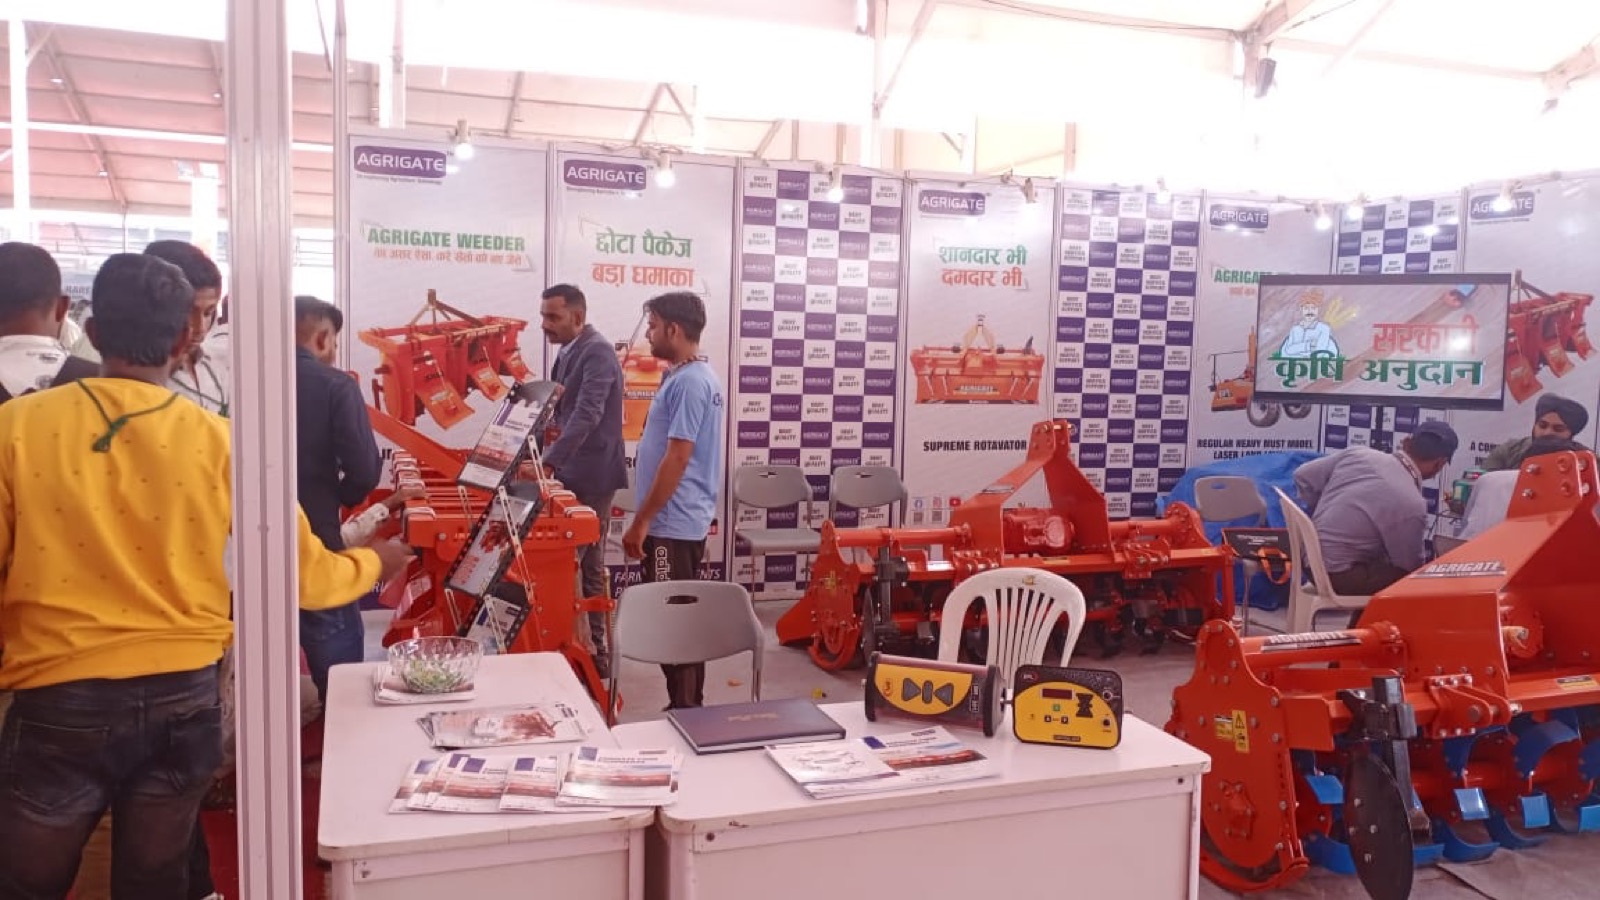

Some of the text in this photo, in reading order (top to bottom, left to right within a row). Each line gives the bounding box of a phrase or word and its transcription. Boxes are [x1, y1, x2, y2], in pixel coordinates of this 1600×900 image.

[357, 152, 444, 172] AGRIGATE
[566, 166, 644, 184] AGRIGATE
[921, 196, 984, 210] AGRIGATE
[1212, 210, 1268, 224] AGRIGATE
[368, 228, 526, 252] AGRIGATE WEEDER
[939, 244, 1027, 266] शानदार भी
[942, 266, 1022, 288] दमदार भी
[1359, 360, 1486, 391] अनुदान
[923, 440, 1027, 452] SUPREME ROTAVATOR
[1197, 438, 1234, 448] REGULAR
[1236, 438, 1262, 448] HEAVY
[1214, 450, 1239, 460] LASER
[1424, 562, 1501, 573] AGRIGATE
